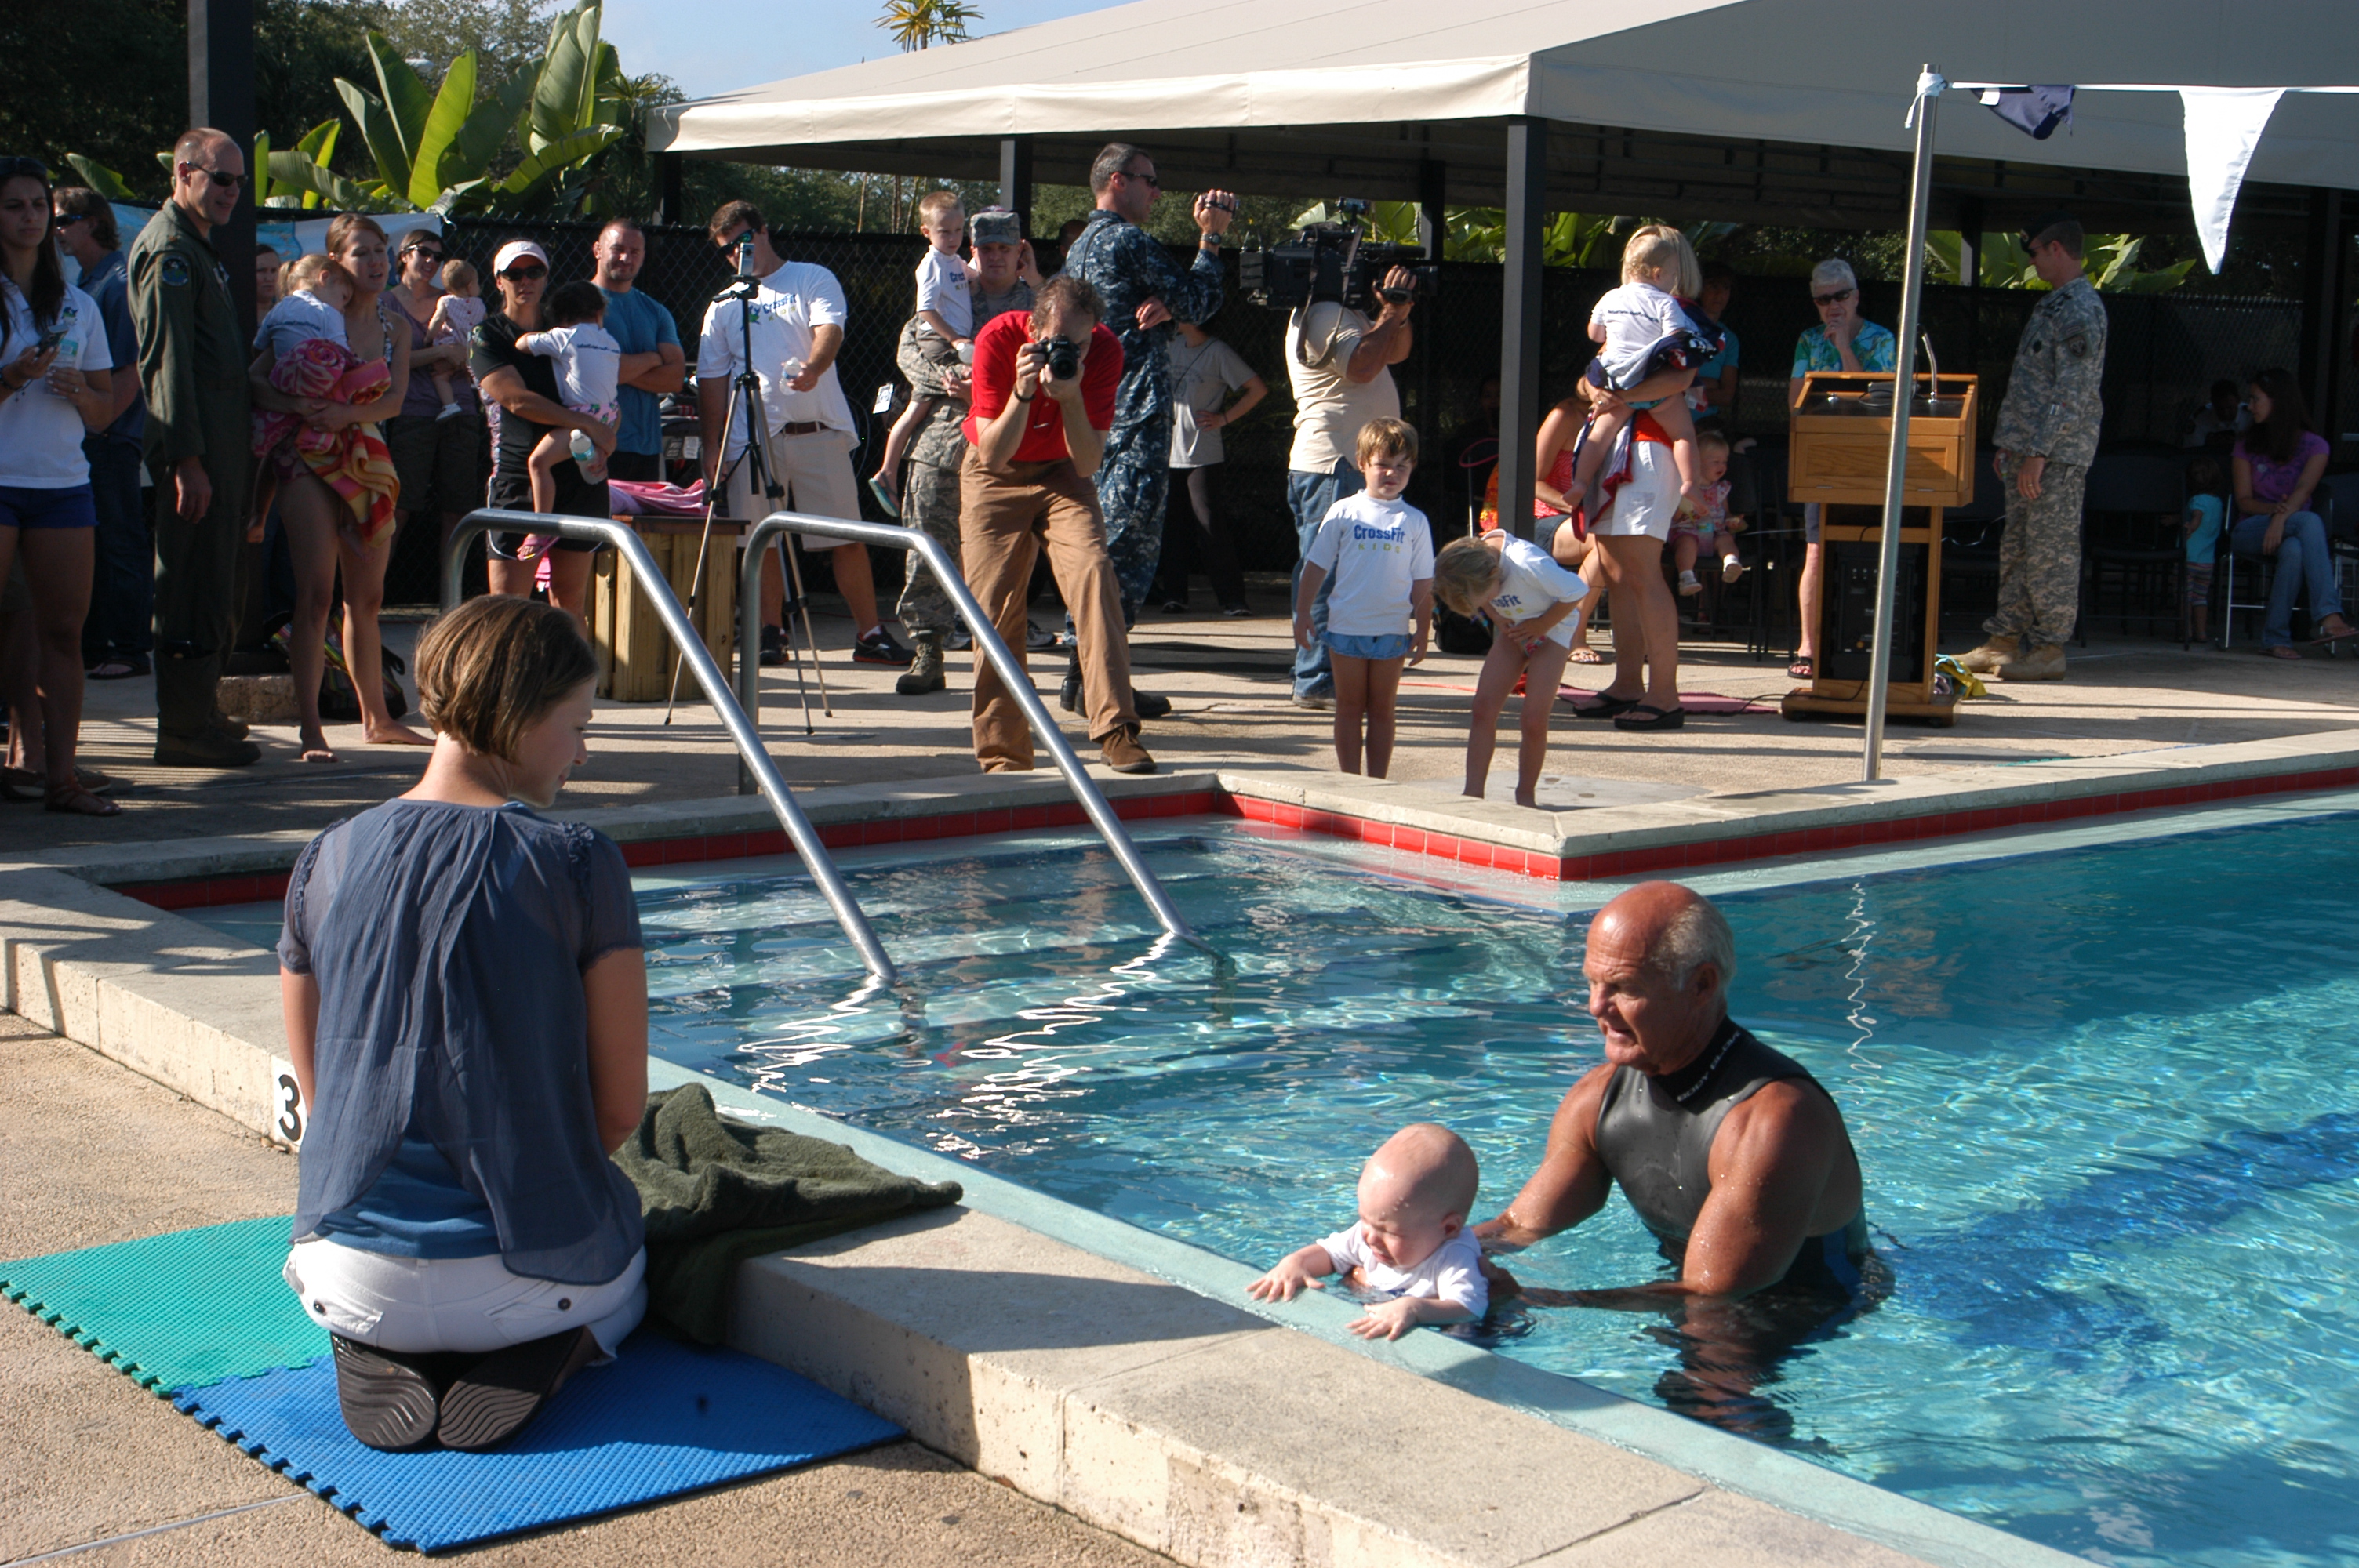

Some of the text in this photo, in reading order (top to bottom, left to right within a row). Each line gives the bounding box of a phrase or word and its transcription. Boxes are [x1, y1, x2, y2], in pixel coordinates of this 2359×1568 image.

[1354, 524, 1405, 544] CrossFit
[1358, 543, 1401, 554] KIDS
[1677, 1071, 1709, 1102] BODY
[278, 1073, 302, 1142] 3
